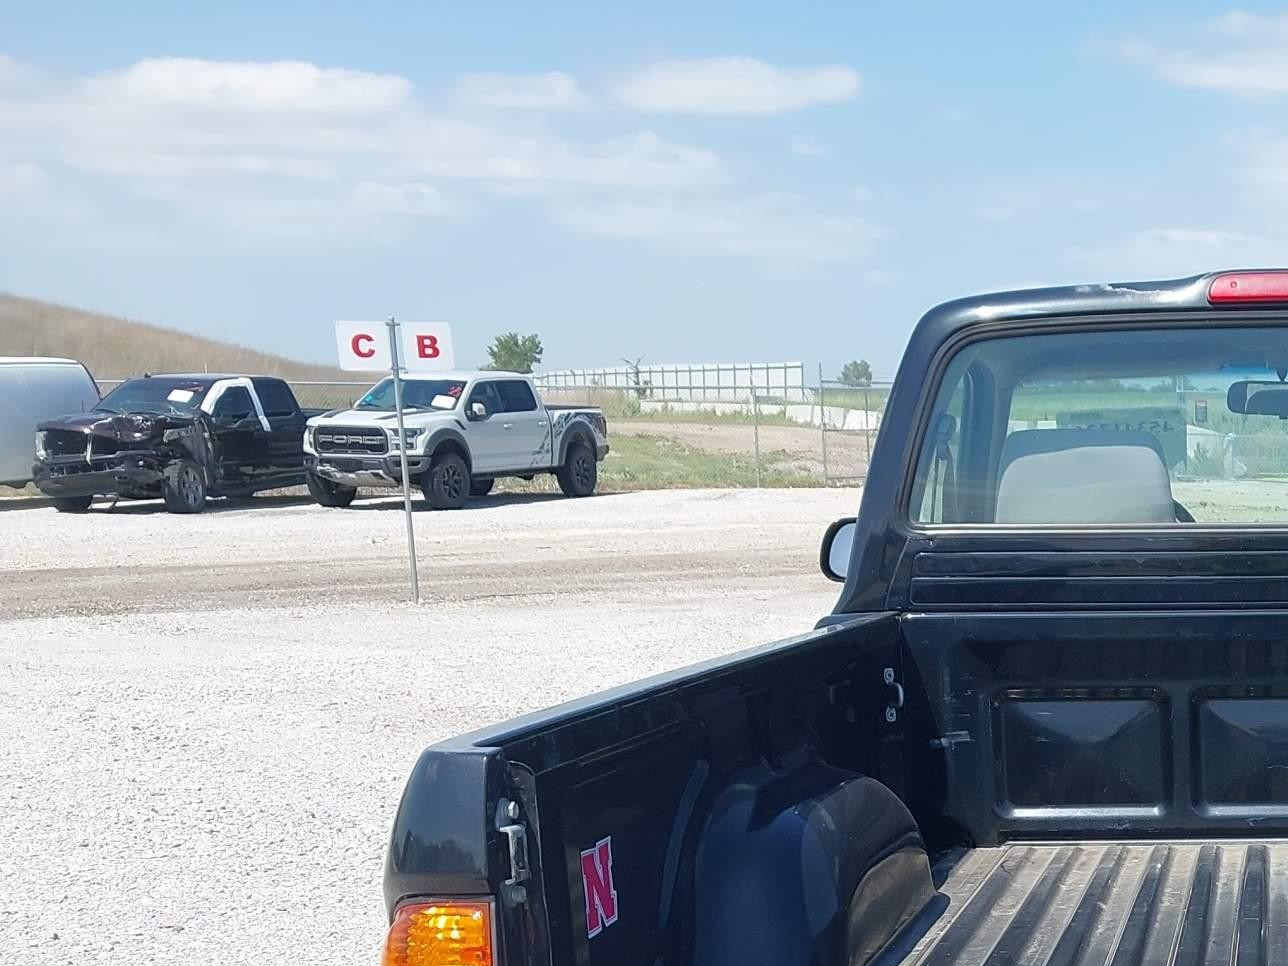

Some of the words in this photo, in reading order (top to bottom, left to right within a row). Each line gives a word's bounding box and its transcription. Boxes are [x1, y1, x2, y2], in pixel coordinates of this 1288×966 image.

[351, 333, 376, 358] C
[416, 334, 440, 359] B
[319, 434, 386, 445] FORD
[580, 835, 618, 939] N
